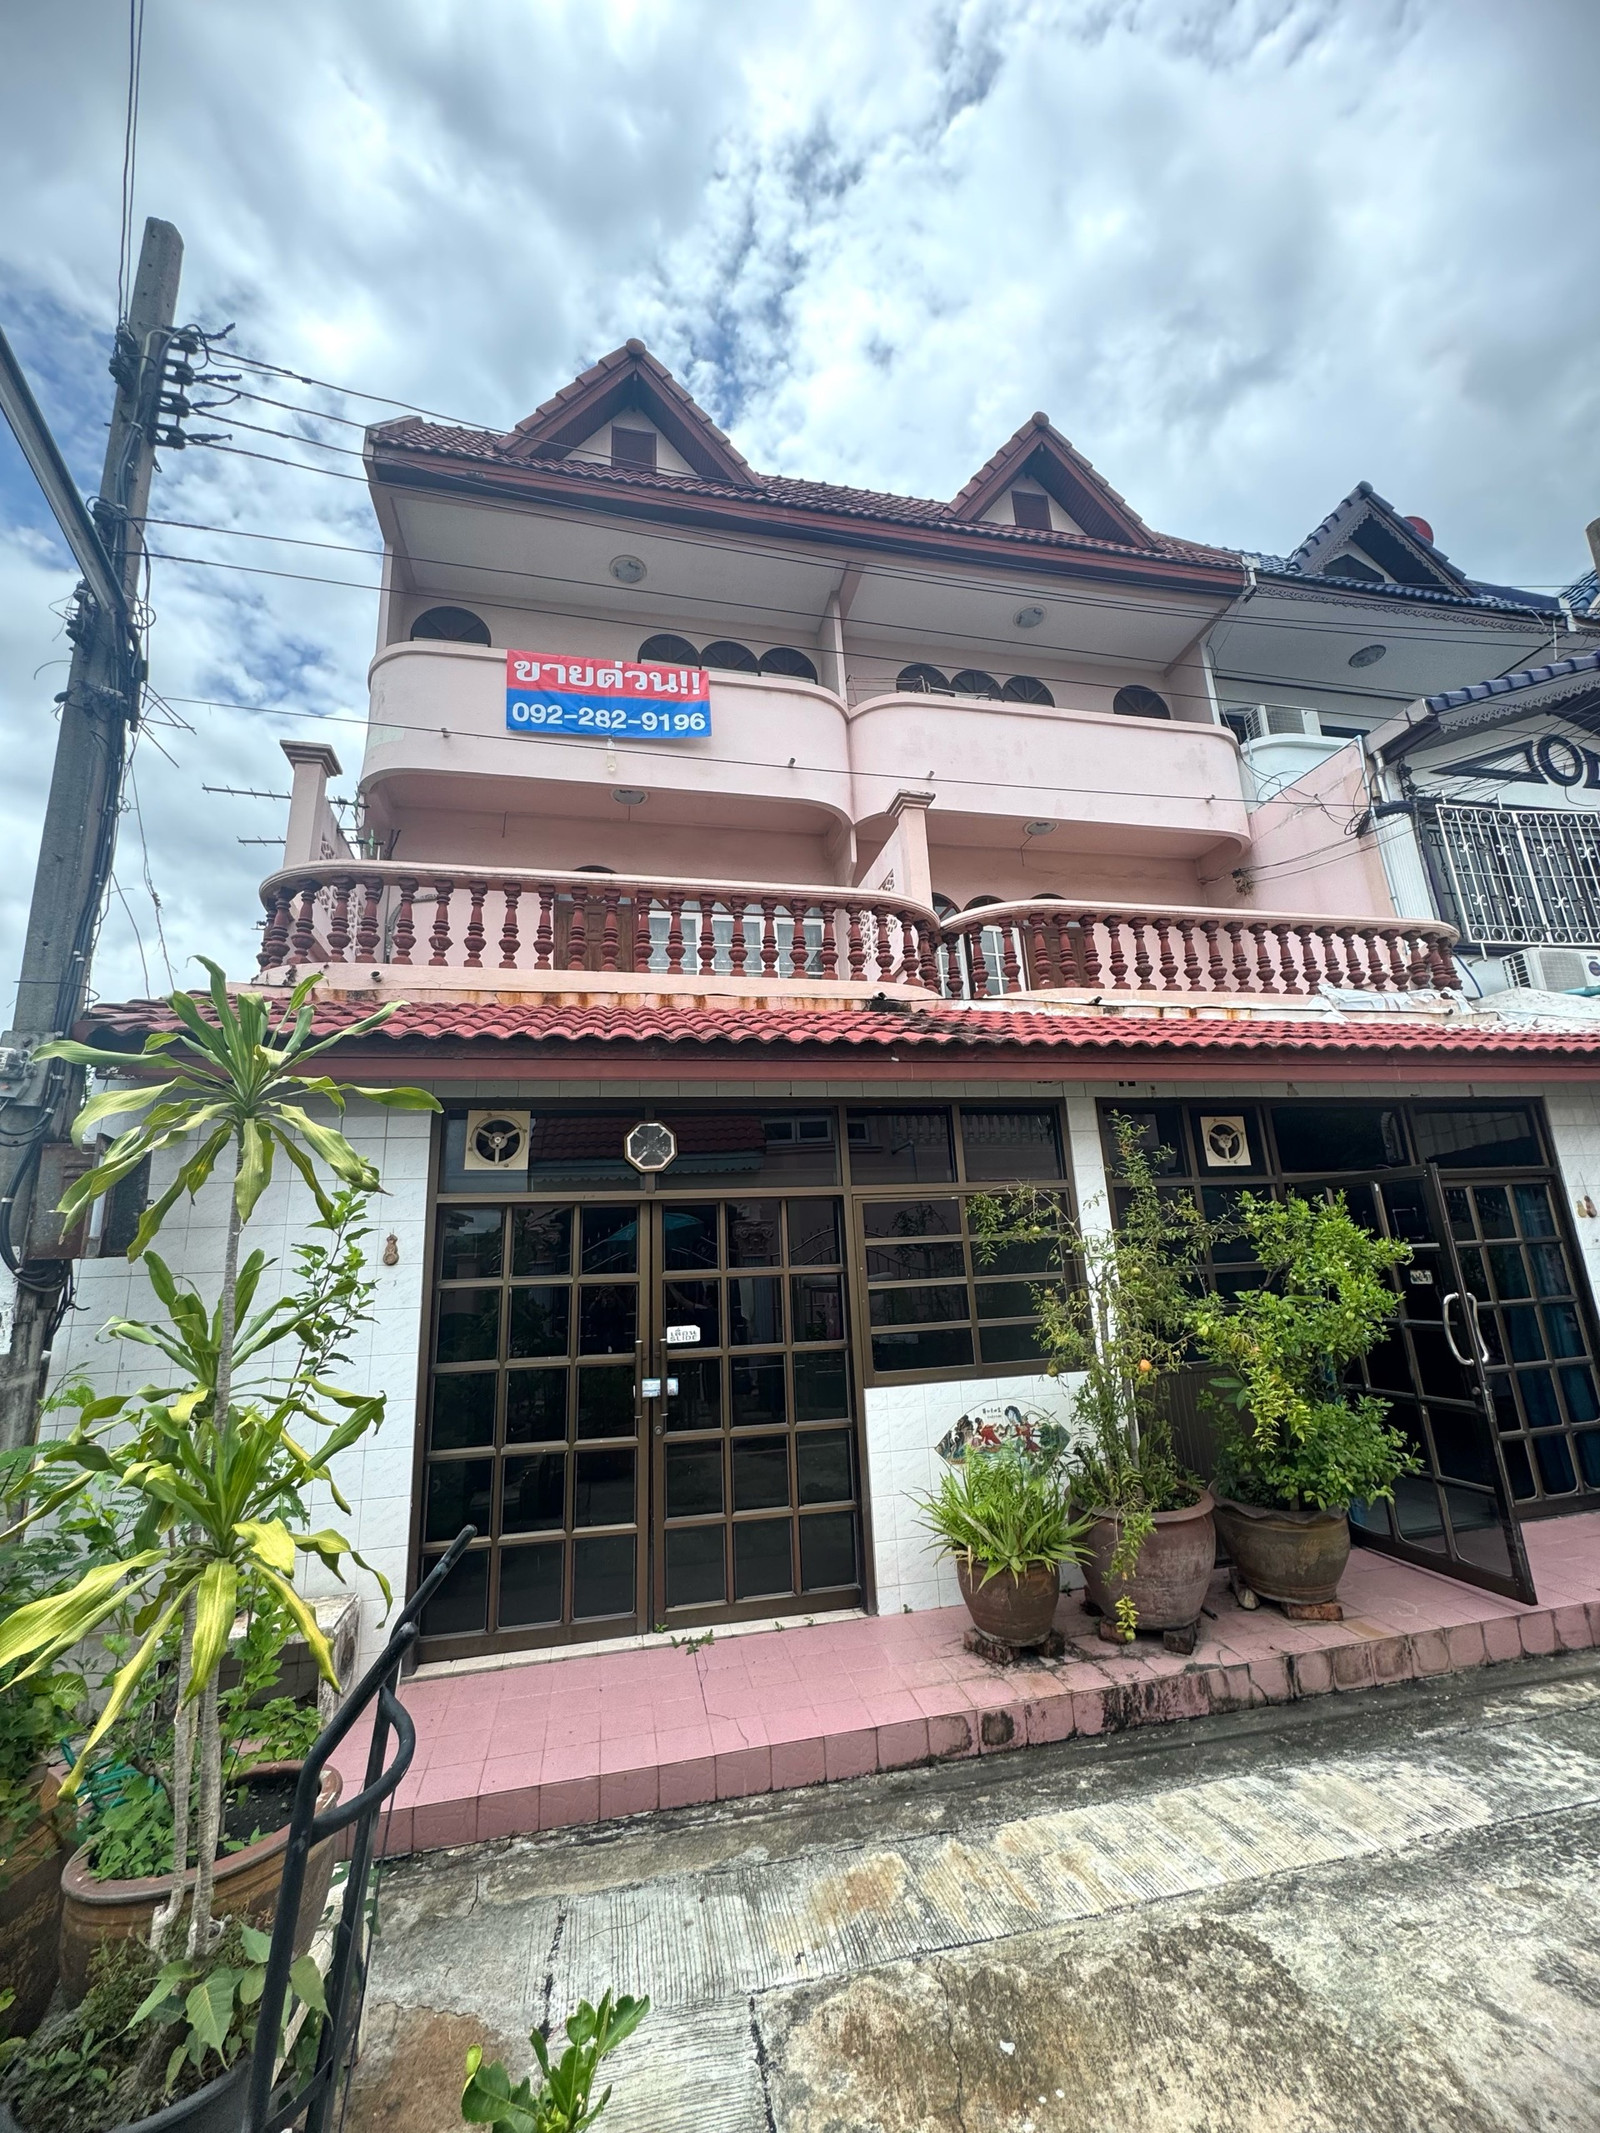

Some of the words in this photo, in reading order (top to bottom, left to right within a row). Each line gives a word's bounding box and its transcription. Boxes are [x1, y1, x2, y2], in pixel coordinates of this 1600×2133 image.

[513, 660, 701, 695] ขายด่วน!!
[512, 702, 706, 732] 092-282-9196
